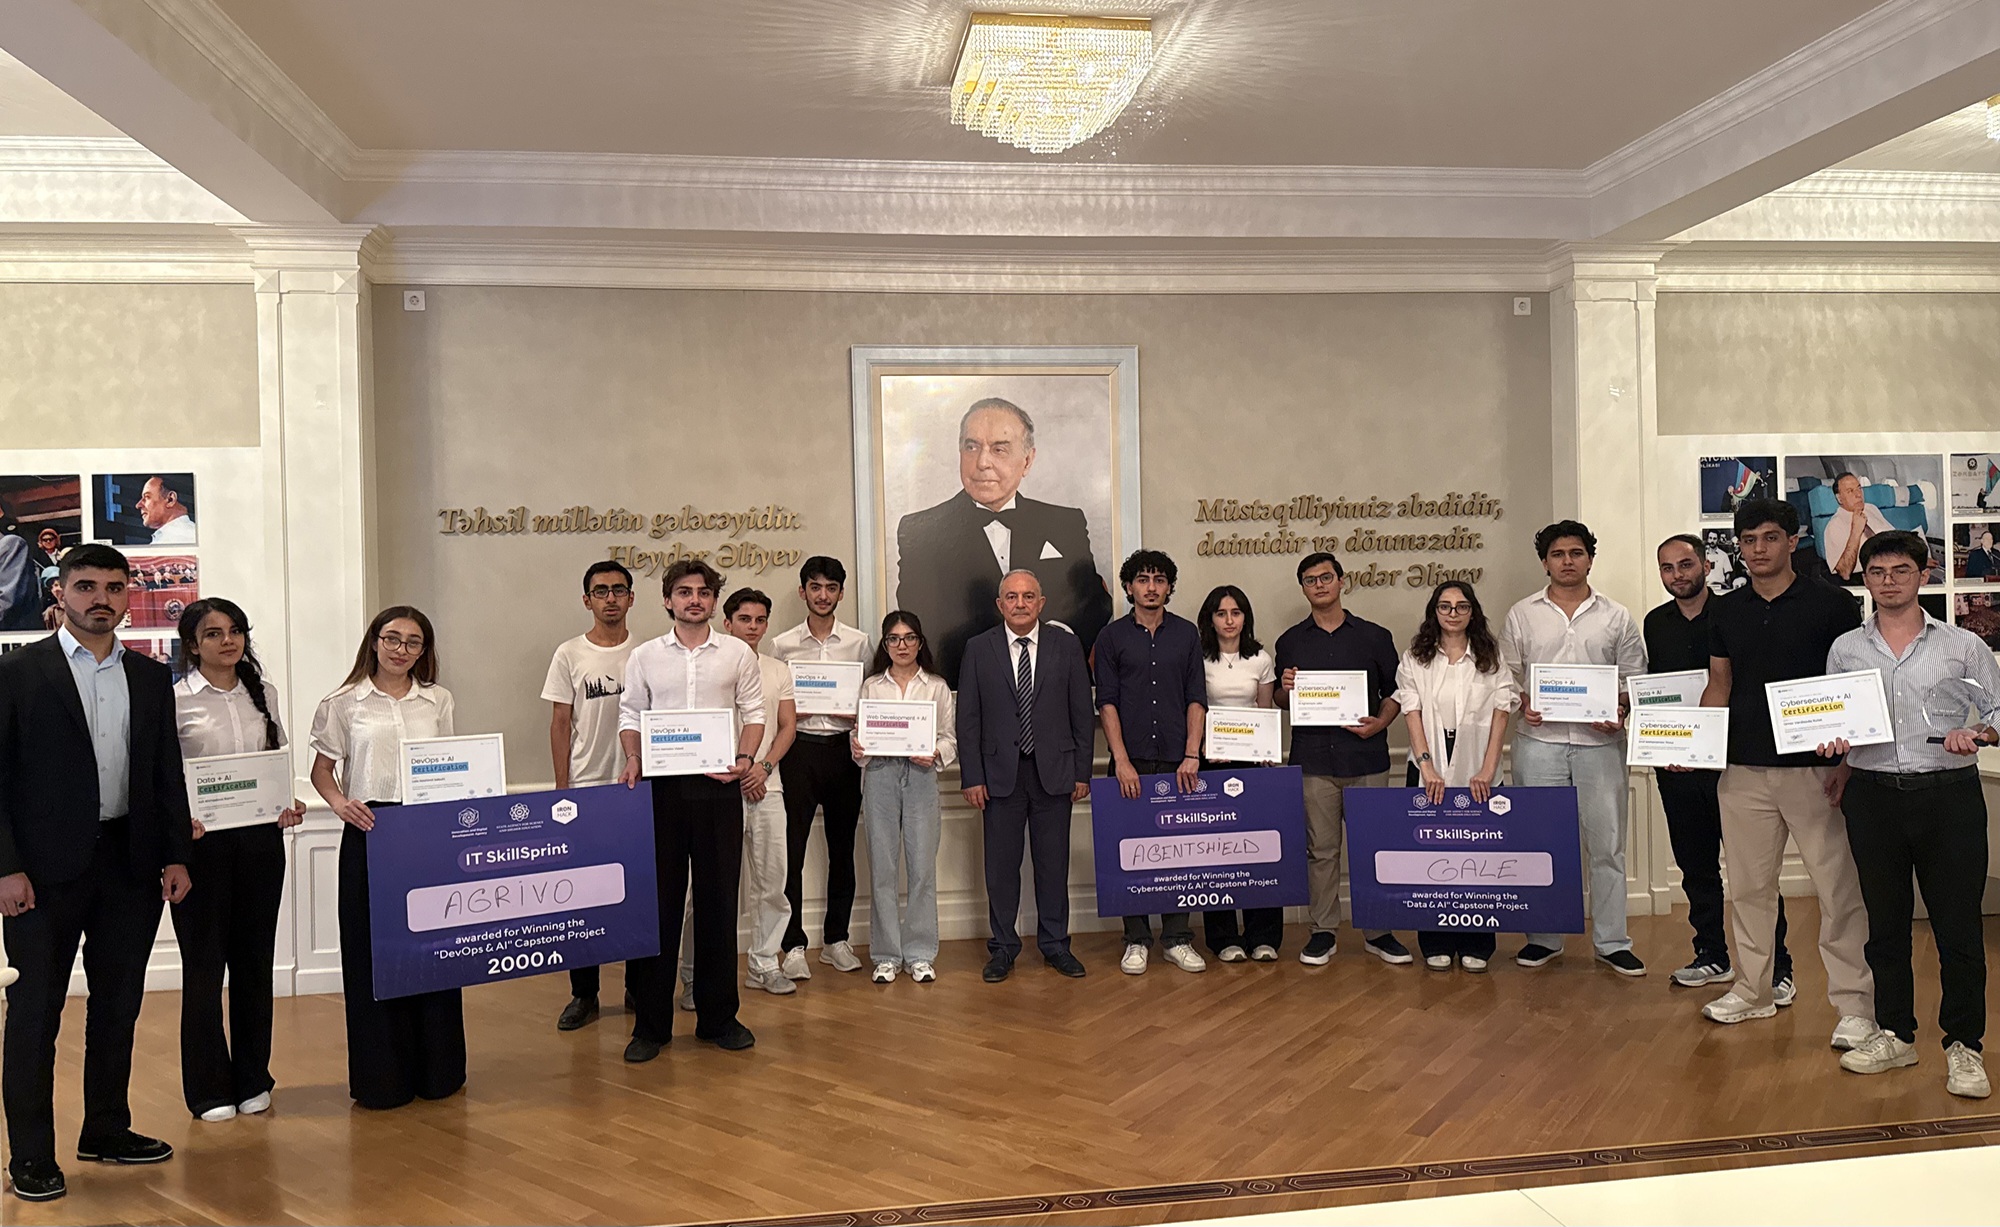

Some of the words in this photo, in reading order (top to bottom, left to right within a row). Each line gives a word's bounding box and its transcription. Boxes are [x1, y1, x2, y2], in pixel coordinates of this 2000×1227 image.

[1195, 495, 1393, 527] Müstəqilliyimiz
[1397, 492, 1503, 520] əbədidir,
[439, 505, 525, 534] Təhsil
[533, 505, 643, 533] millətin
[651, 504, 801, 538] gələcəyidir.
[1197, 529, 1307, 556] daimidir
[1312, 535, 1339, 552] və
[1345, 526, 1484, 552] dönməzdir.
[716, 542, 802, 575] Əliyev
[1343, 563, 1403, 594] ydər
[1780, 696, 1835, 707] Cybersecurity
[1783, 703, 1843, 716] Certification
[412, 763, 468, 774] Certification
[199, 780, 256, 794] Certification
[1161, 814, 1173, 825] IT
[1176, 811, 1237, 825] SkillSprint
[1419, 830, 1432, 839] IT
[1436, 828, 1504, 842] SkillSprint
[466, 852, 482, 866] IT
[486, 842, 569, 864] SkillSprint
[1154, 873, 1188, 883] awarded
[1189, 872, 1200, 881] for
[1202, 871, 1235, 882] Winning
[1236, 870, 1250, 878] the
[1427, 858, 1518, 882] GALE
[1209, 880, 1247, 890] Capstone
[1249, 878, 1278, 888] Project
[1177, 893, 1219, 908] 2000
[1412, 892, 1448, 900] awarded
[1450, 892, 1464, 900] for
[1464, 892, 1501, 902] Winning
[1502, 892, 1518, 900] the
[1452, 902, 1494, 911] Capstone
[1496, 902, 1528, 912] Project
[1438, 914, 1484, 928] 2000
[455, 928, 502, 945] awarded
[504, 926, 520, 938] for
[522, 920, 566, 936] Winning
[568, 917, 586, 930] the
[486, 942, 494, 952] &
[514, 932, 566, 949] Capstone
[568, 926, 606, 943] Project
[488, 951, 544, 975] 2000
